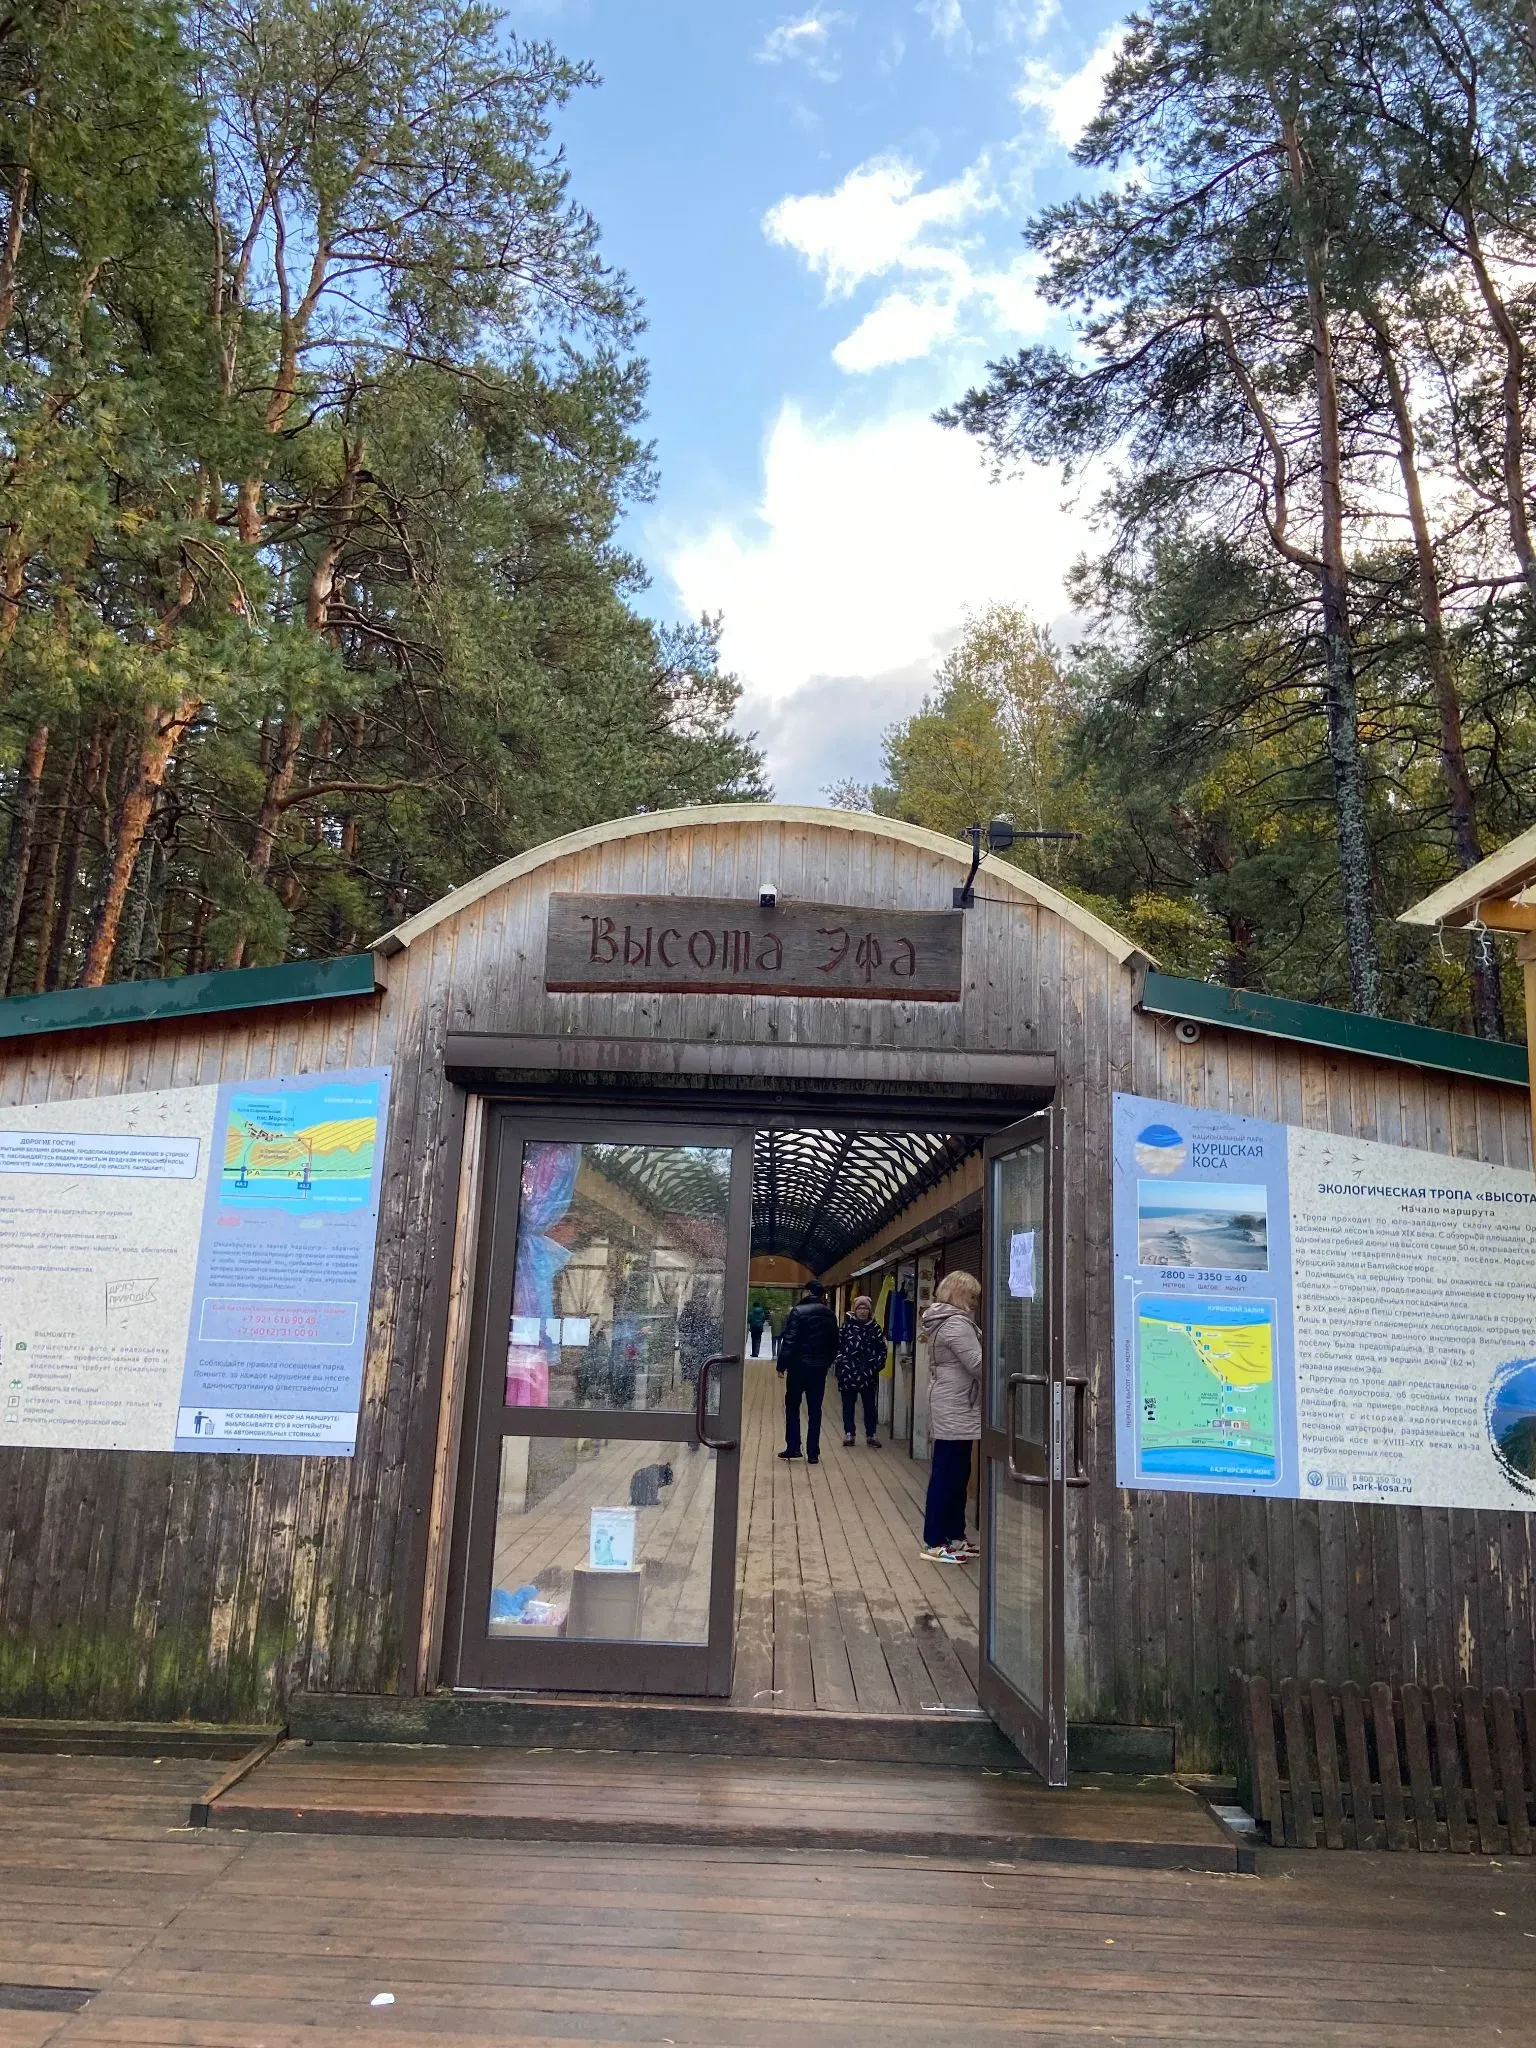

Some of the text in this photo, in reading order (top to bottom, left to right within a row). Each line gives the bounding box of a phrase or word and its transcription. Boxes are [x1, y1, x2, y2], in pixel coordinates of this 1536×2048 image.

[581, 915, 917, 983] Высота Эфа
[1192, 1134, 1245, 1142] НАЦИОНАЛЬНЫЙ
[1192, 1143, 1263, 1157] КУРШСКАЯ
[1192, 1156, 1228, 1169] КОСА
[1318, 1184, 1426, 1198] ЭКОЛОГИЧЕСКАЯ
[1430, 1189, 1472, 1200] ТРОПА
[1401, 1204, 1495, 1217] Начало маршрута
[1302, 1213, 1326, 1223] Тропа
[1332, 1216, 1371, 1224] проходит
[1392, 1218, 1457, 1229] юго-западному
[1463, 1222, 1491, 1230] склону
[1296, 1260, 1335, 1268] Куршский
[1160, 1270, 1247, 1282] 2800 3350 40
[1305, 1270, 1354, 1280] Поднявшись
[1370, 1275, 1404, 1283] вершину
[108, 1282, 135, 1294] ДРУГУ
[1334, 1340, 1355, 1348] была
[1430, 1335, 1476, 1345] инспектора
[1315, 1352, 1352, 1360] событиях
[200, 1360, 245, 1368] Соблюдайте
[279, 1363, 321, 1371] посещения
[1334, 1364, 1364, 1372] именем
[1310, 1374, 1346, 1384] Прогулка
[202, 1382, 274, 1391] административную
[1300, 1387, 1334, 1395] рельефе
[1397, 1390, 1406, 1399] об
[1367, 1402, 1401, 1410] примере
[1301, 1410, 1344, 1418] знакомит
[292, 1422, 331, 1430] КОНТЕЙНЕРЫ
[1302, 1422, 1340, 1431] песчаной
[1302, 1446, 1337, 1454] вырубки
[1353, 1482, 1412, 1493] park-kosa.ru
